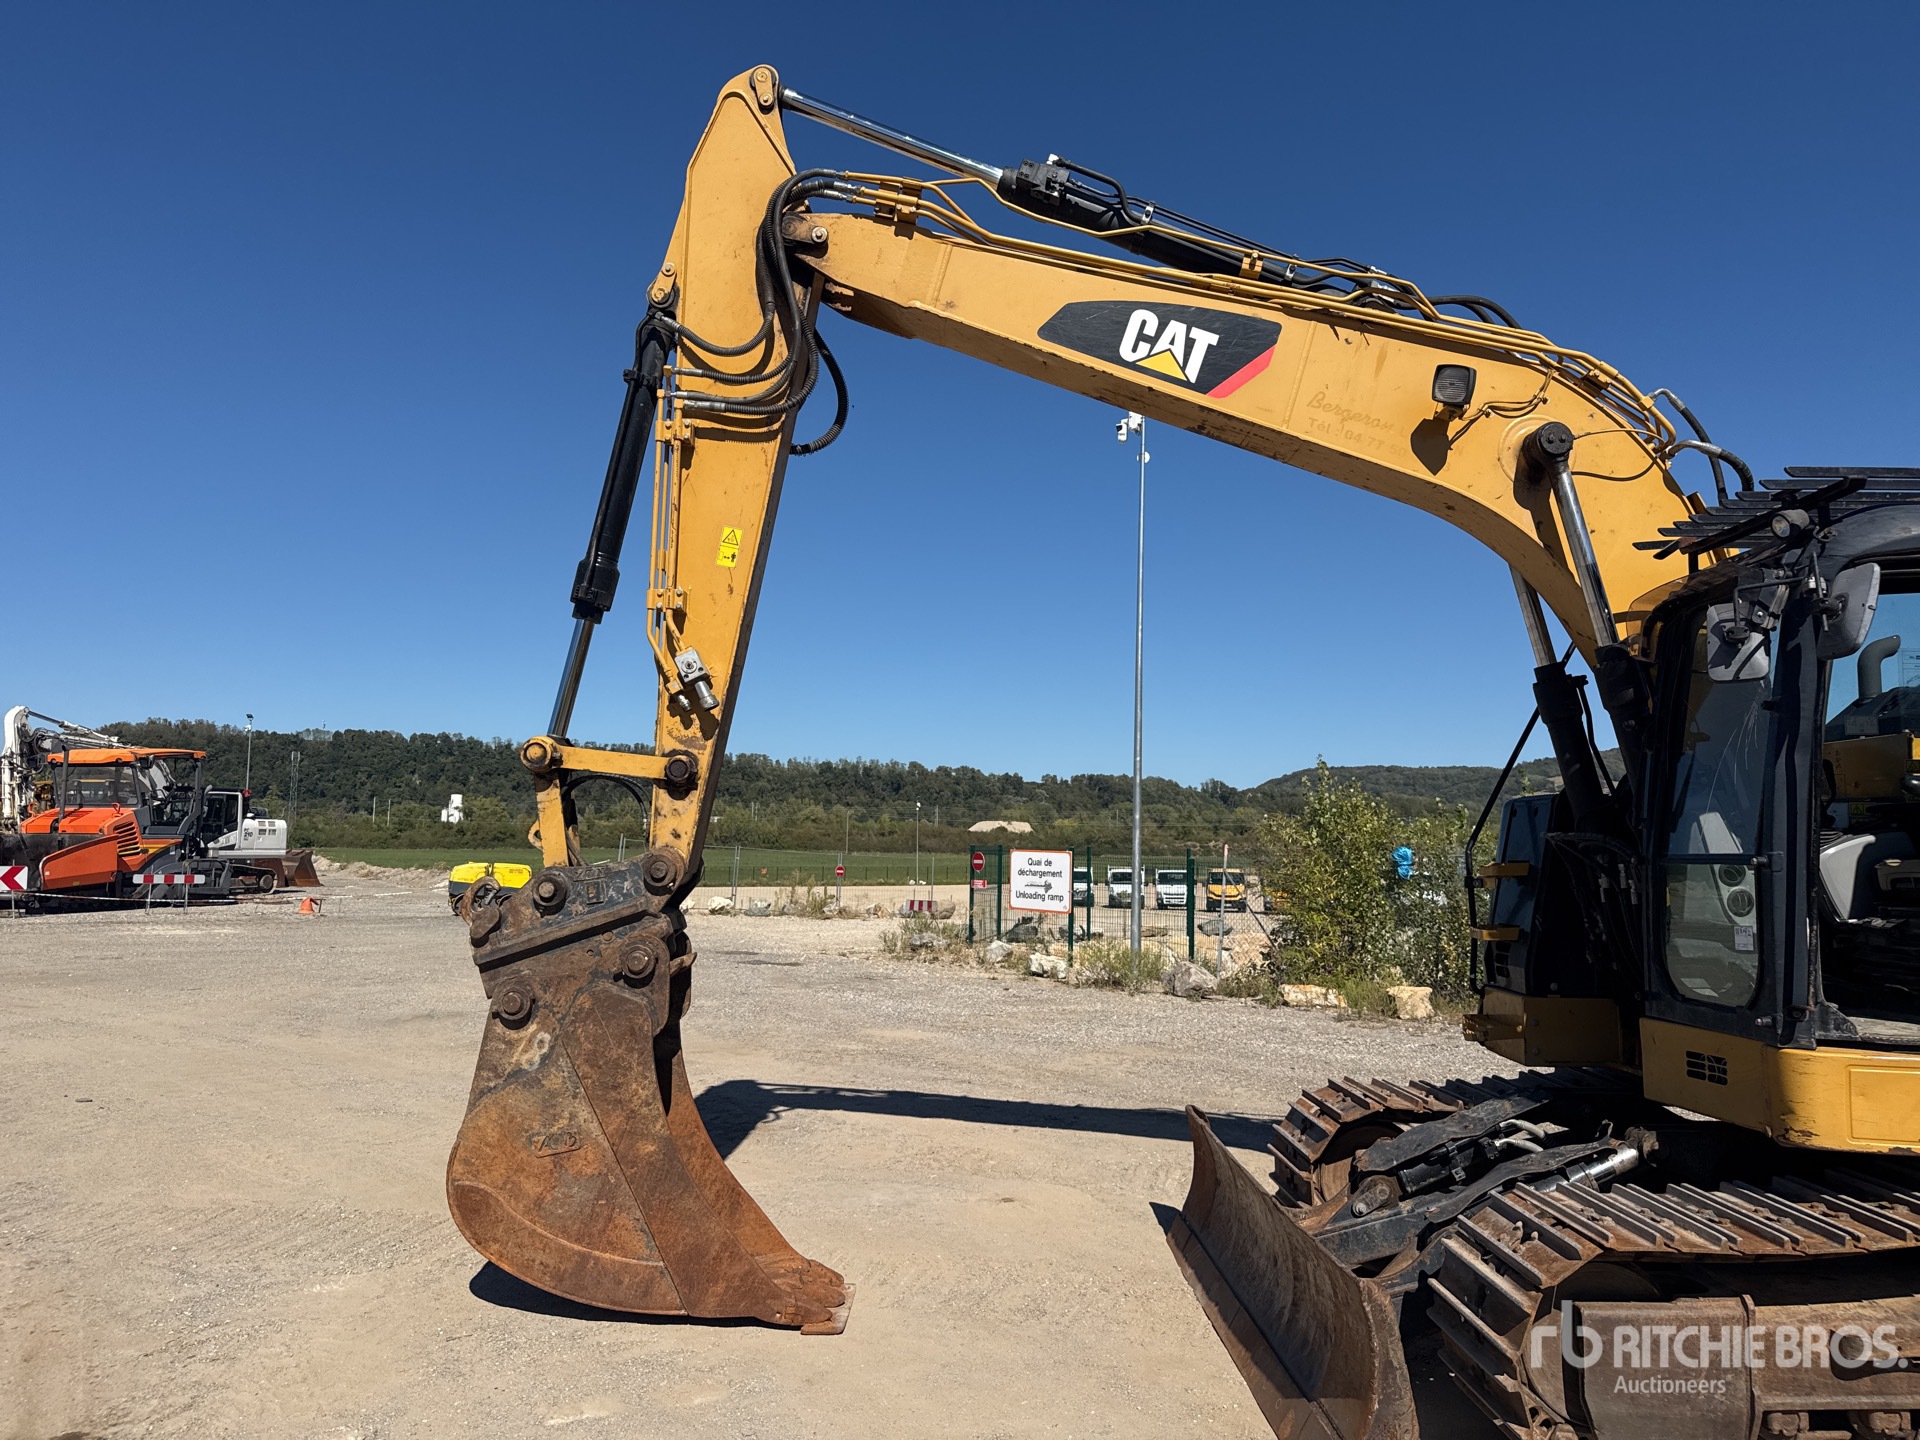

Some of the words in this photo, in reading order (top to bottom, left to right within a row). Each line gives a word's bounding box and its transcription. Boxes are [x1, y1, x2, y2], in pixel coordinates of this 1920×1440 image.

[1119, 309, 1220, 384] CAT
[1028, 858, 1042, 866] Quai
[1044, 858, 1052, 867] de
[1018, 868, 1062, 878] déchargement
[1015, 890, 1046, 902] Unloading
[1048, 894, 1064, 903] ramp
